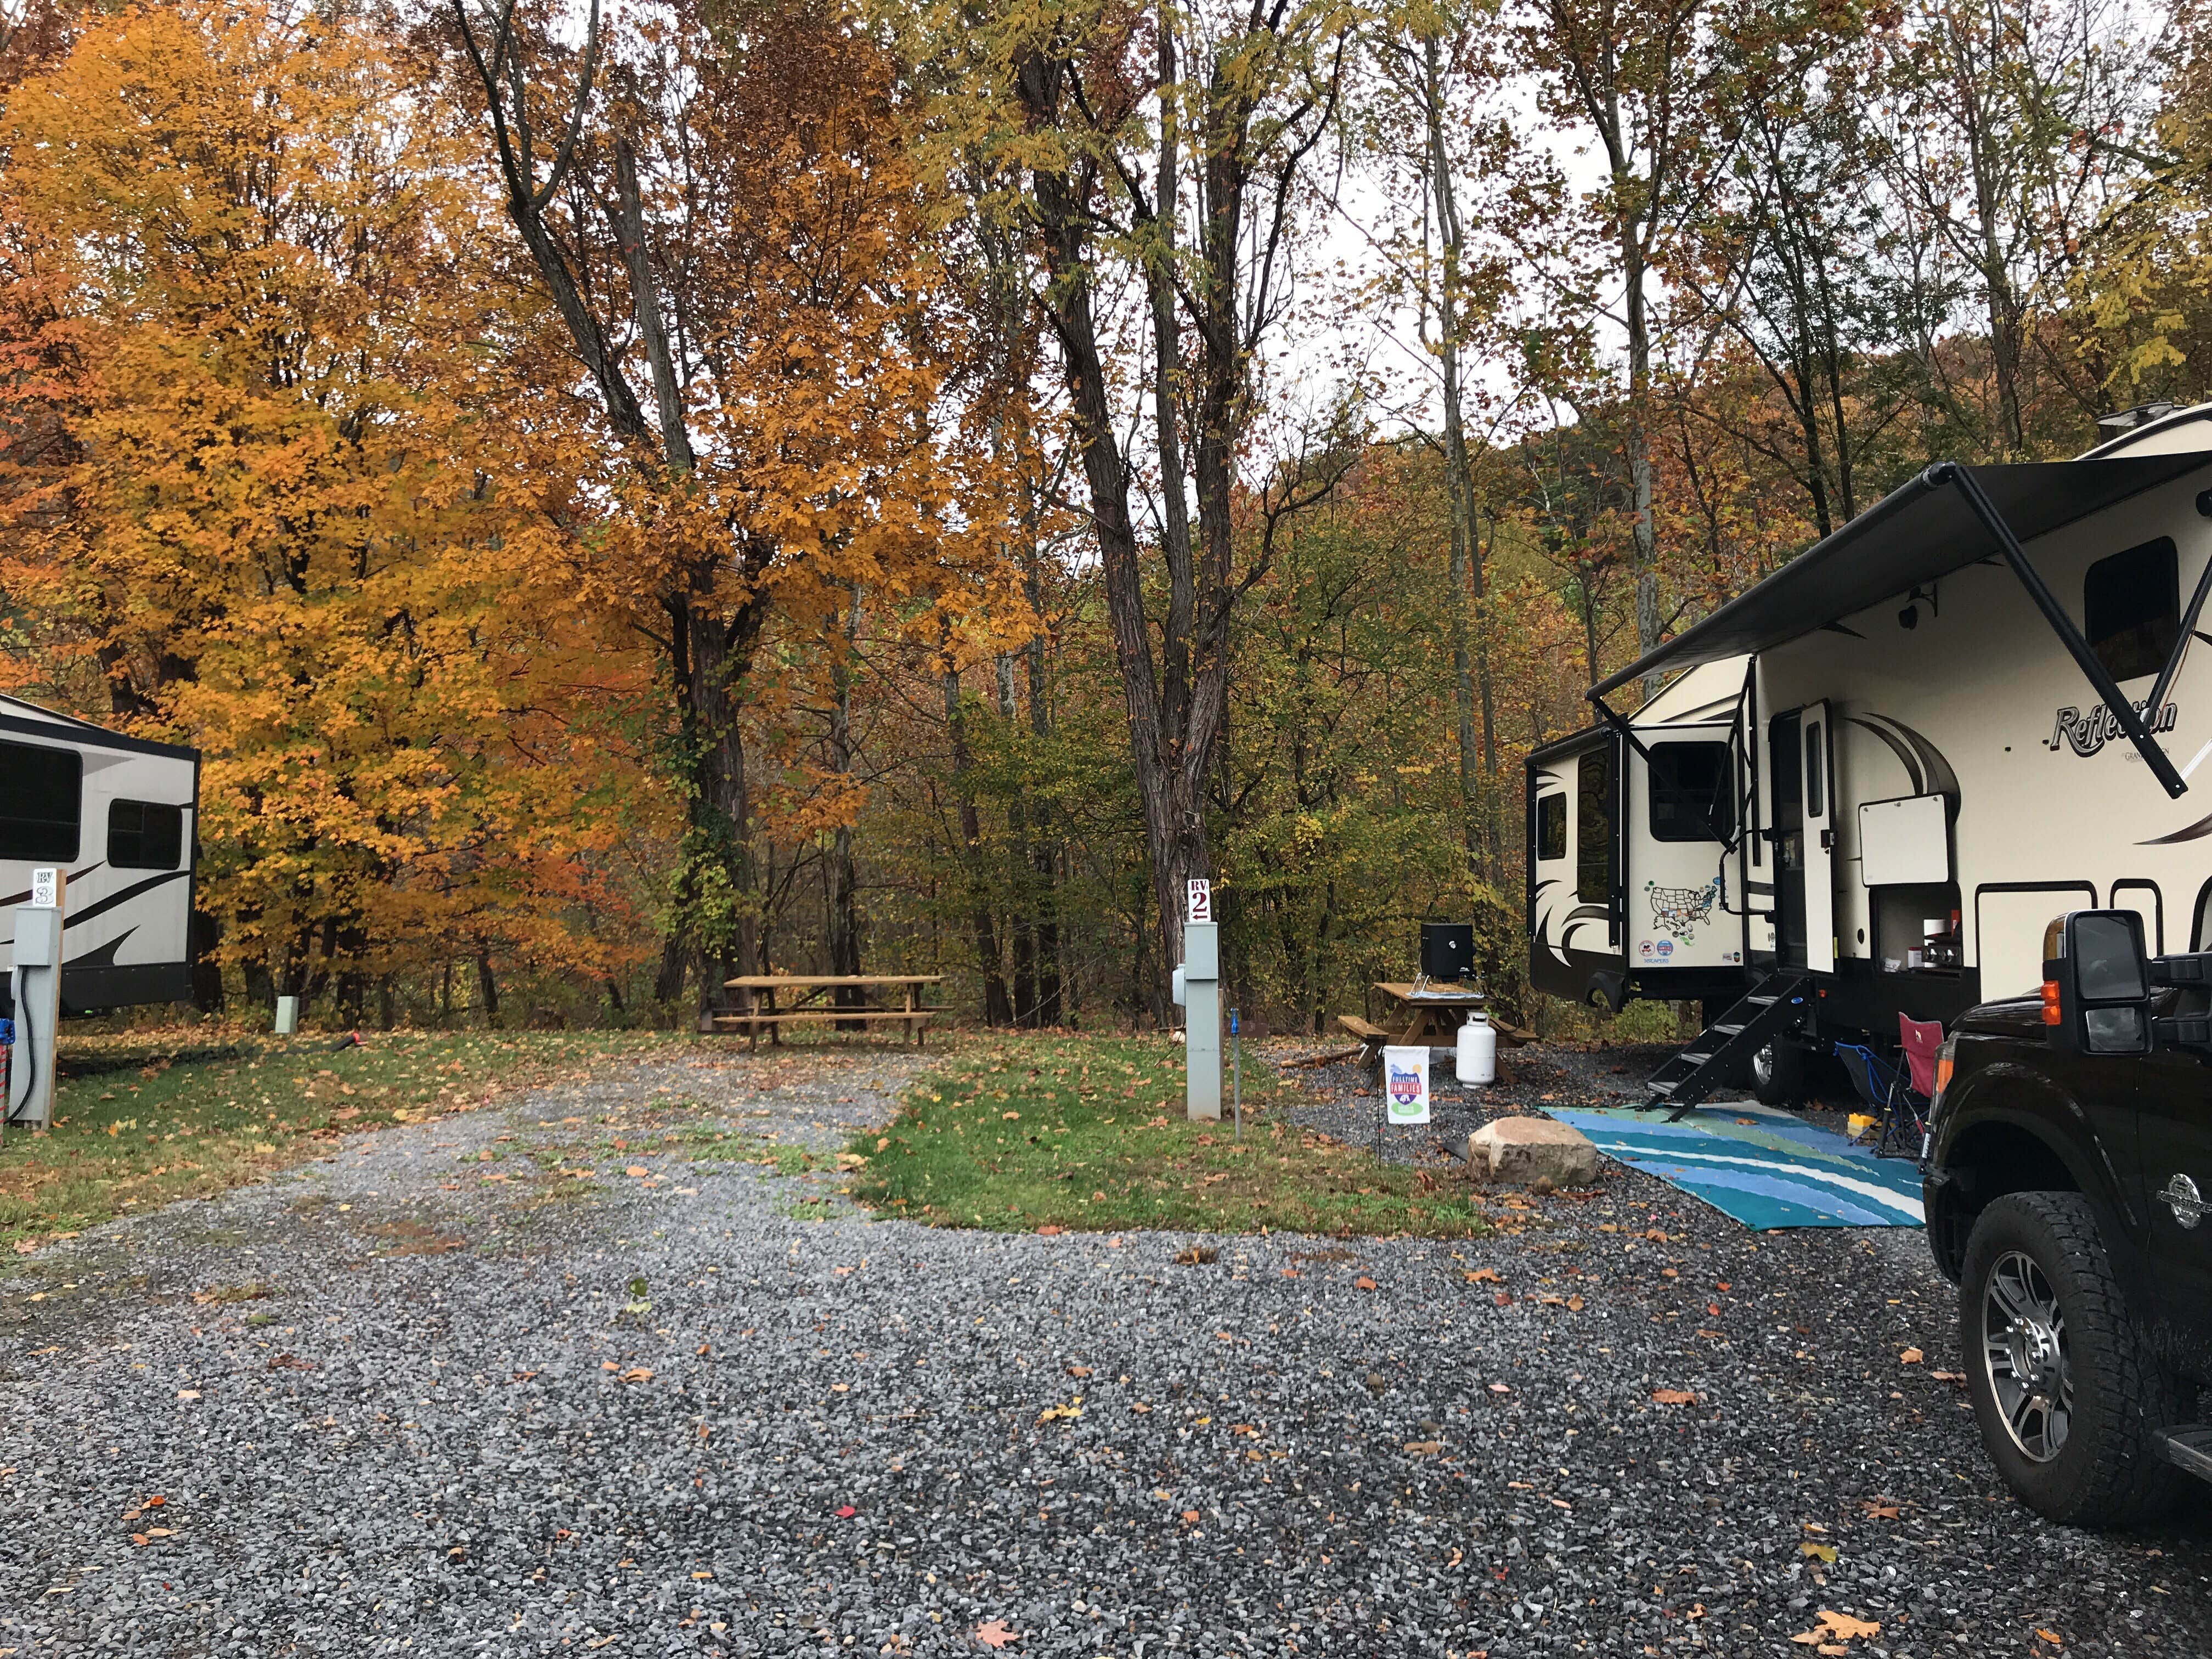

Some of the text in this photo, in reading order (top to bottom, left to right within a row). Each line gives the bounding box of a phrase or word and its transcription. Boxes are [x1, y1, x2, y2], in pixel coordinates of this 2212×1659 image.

[2050, 699, 2177, 758] Reflecn
[37, 872, 53, 883] RV
[1190, 880, 1207, 891] RV
[35, 885, 54, 905] 3
[1192, 892, 1207, 912] 2
[1391, 1084, 1420, 1093] FAMILIES
[2157, 1191, 2212, 1212] POWER STROKE
